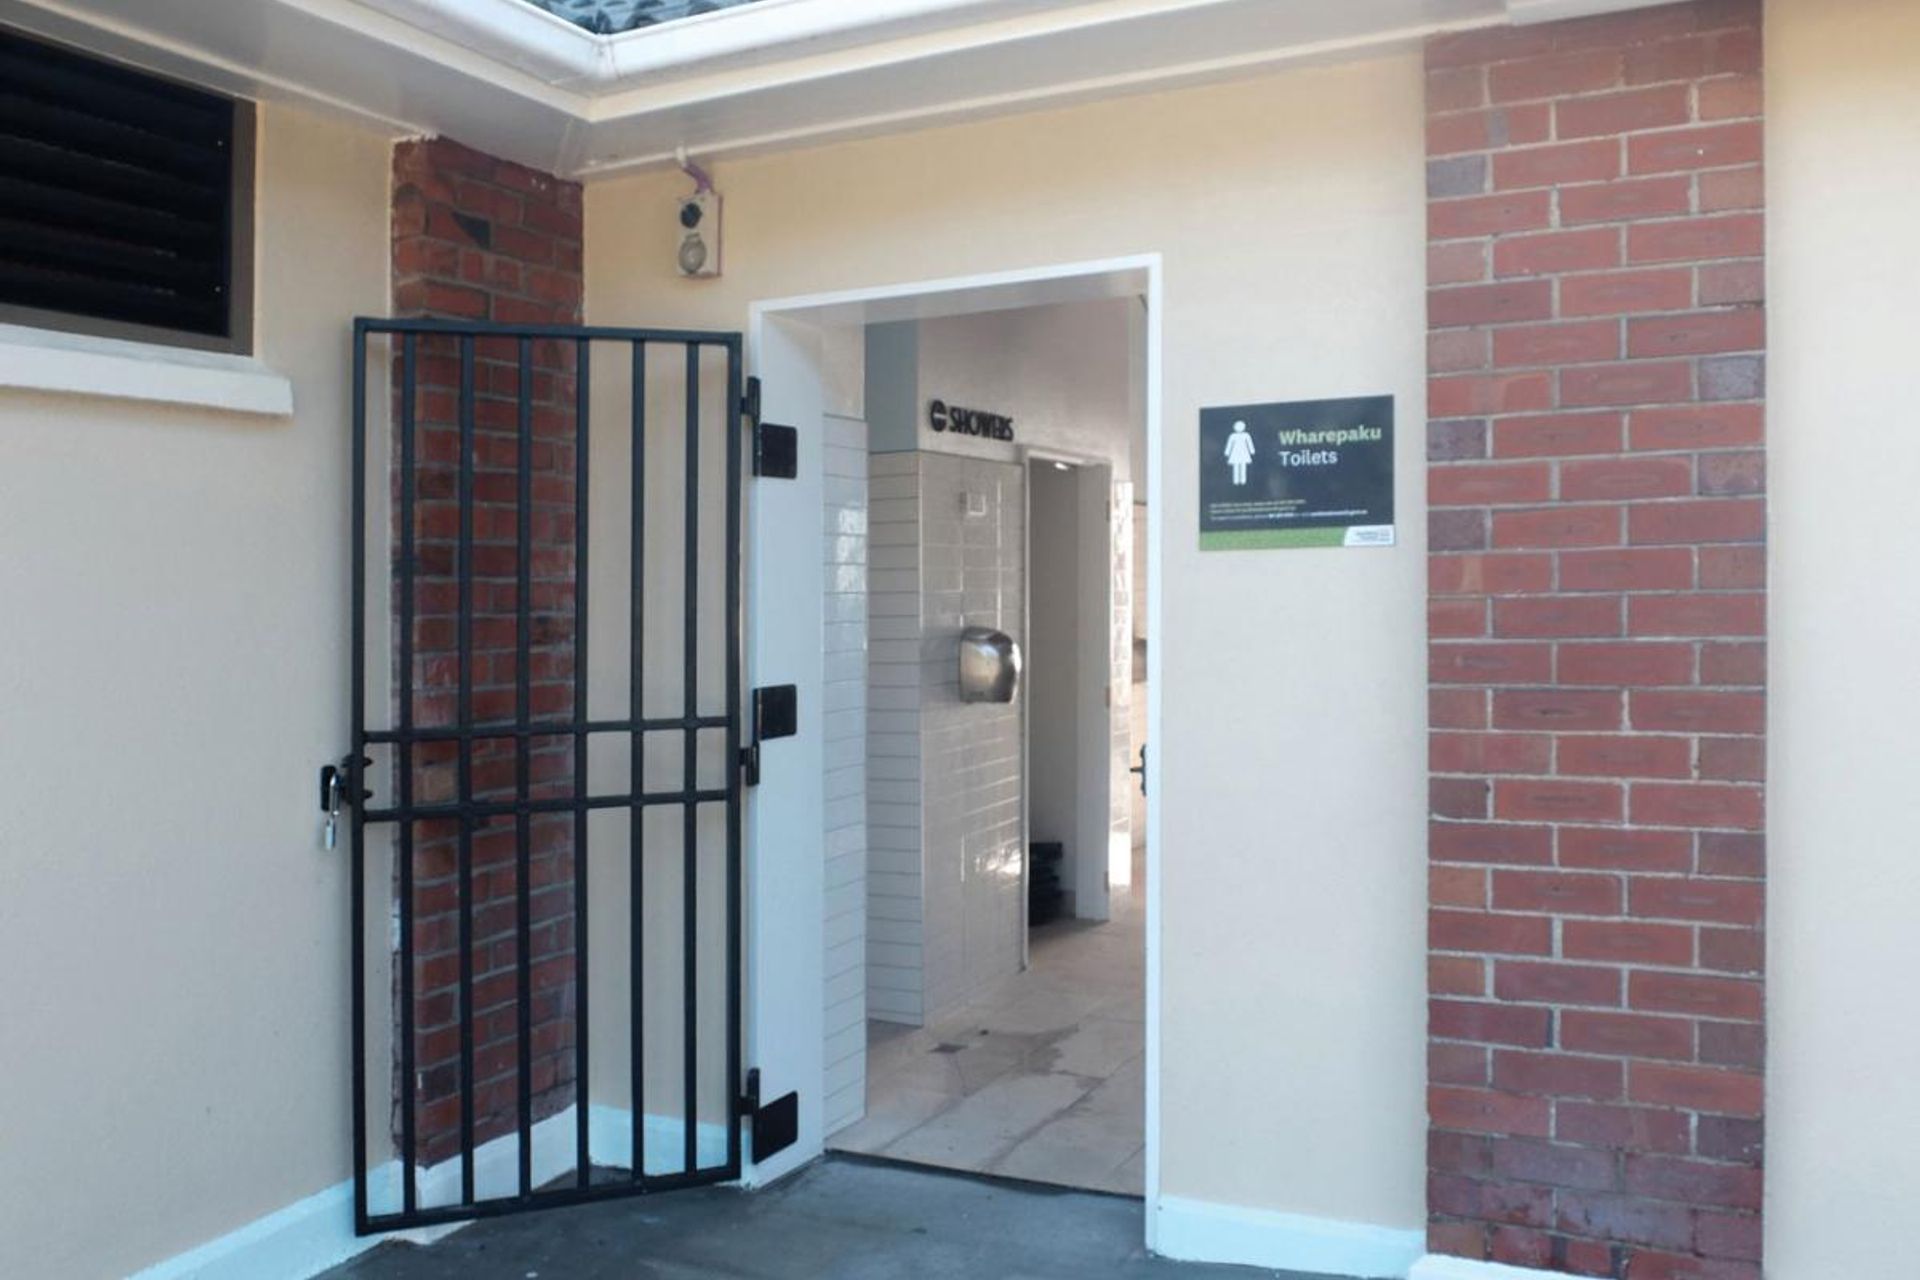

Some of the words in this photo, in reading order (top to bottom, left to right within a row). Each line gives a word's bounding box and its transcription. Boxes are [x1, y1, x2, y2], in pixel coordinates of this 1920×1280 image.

[949, 406, 1014, 442] SHOWERS
[1278, 424, 1382, 445] Wharepaku
[1278, 449, 1338, 467] Toilets
